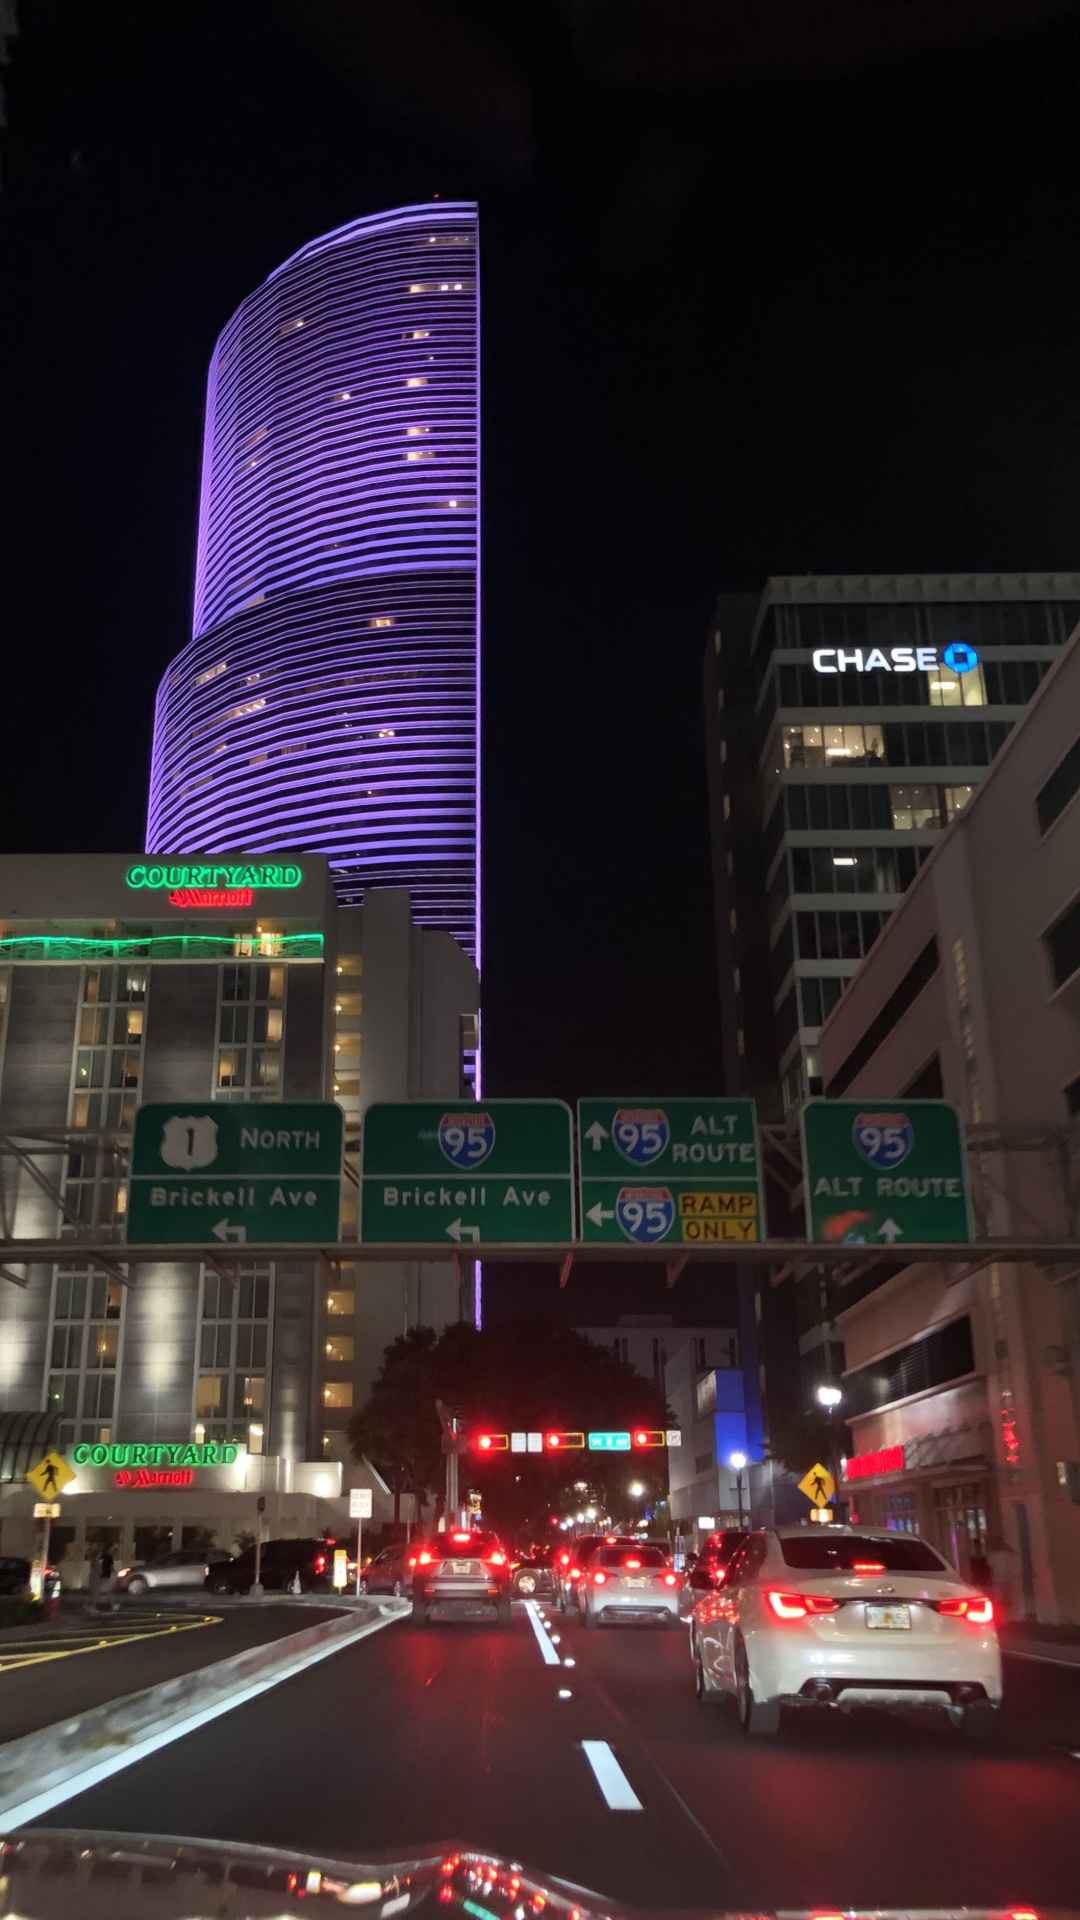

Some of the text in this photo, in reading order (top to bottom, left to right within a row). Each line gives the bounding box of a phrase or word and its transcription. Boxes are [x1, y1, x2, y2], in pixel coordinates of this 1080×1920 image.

[812, 647, 940, 673] CHASE
[126, 865, 302, 888] COURTYARD
[180, 889, 254, 908] Marriott
[690, 1115, 738, 1136] ALT
[186, 1126, 195, 1156] 1
[240, 1127, 320, 1149] NORTH
[445, 1126, 487, 1158] 95
[618, 1123, 662, 1155] 95
[860, 1127, 906, 1159] 95
[672, 1142, 756, 1163] ROUTE
[151, 1186, 318, 1207] Brickell Ave
[383, 1186, 551, 1207] Brickell Ave
[813, 1176, 961, 1198] ALT ROUTE
[681, 1195, 753, 1213] RAMP
[622, 1202, 667, 1234] 95
[685, 1220, 753, 1239] ONLY
[73, 1443, 239, 1467] COURTYARD
[131, 1468, 194, 1487] Marriott
